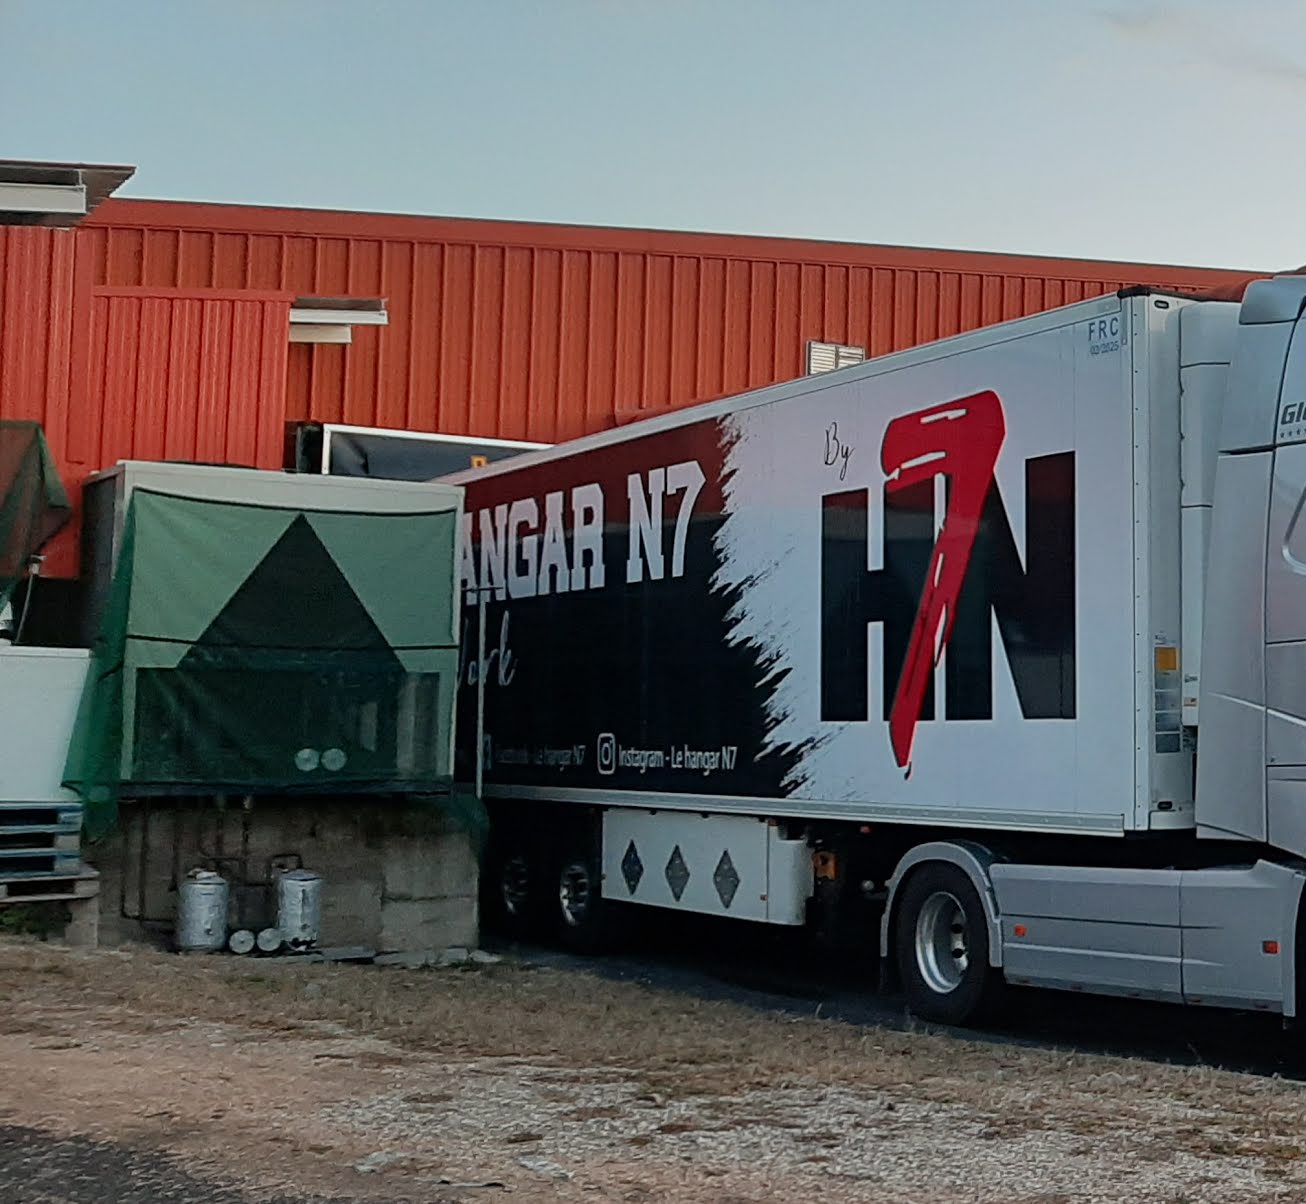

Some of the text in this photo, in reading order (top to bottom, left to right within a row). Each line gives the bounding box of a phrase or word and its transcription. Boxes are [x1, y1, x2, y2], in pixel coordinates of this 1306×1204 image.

[1088, 317, 1119, 341] FRC
[823, 420, 856, 482] By
[460, 460, 707, 606] ANGAR N7
[459, 610, 520, 686] ork
[619, 745, 664, 773] Instagram
[671, 746, 683, 768] Le
[685, 745, 720, 776] hangar
[721, 746, 738, 770] N7
